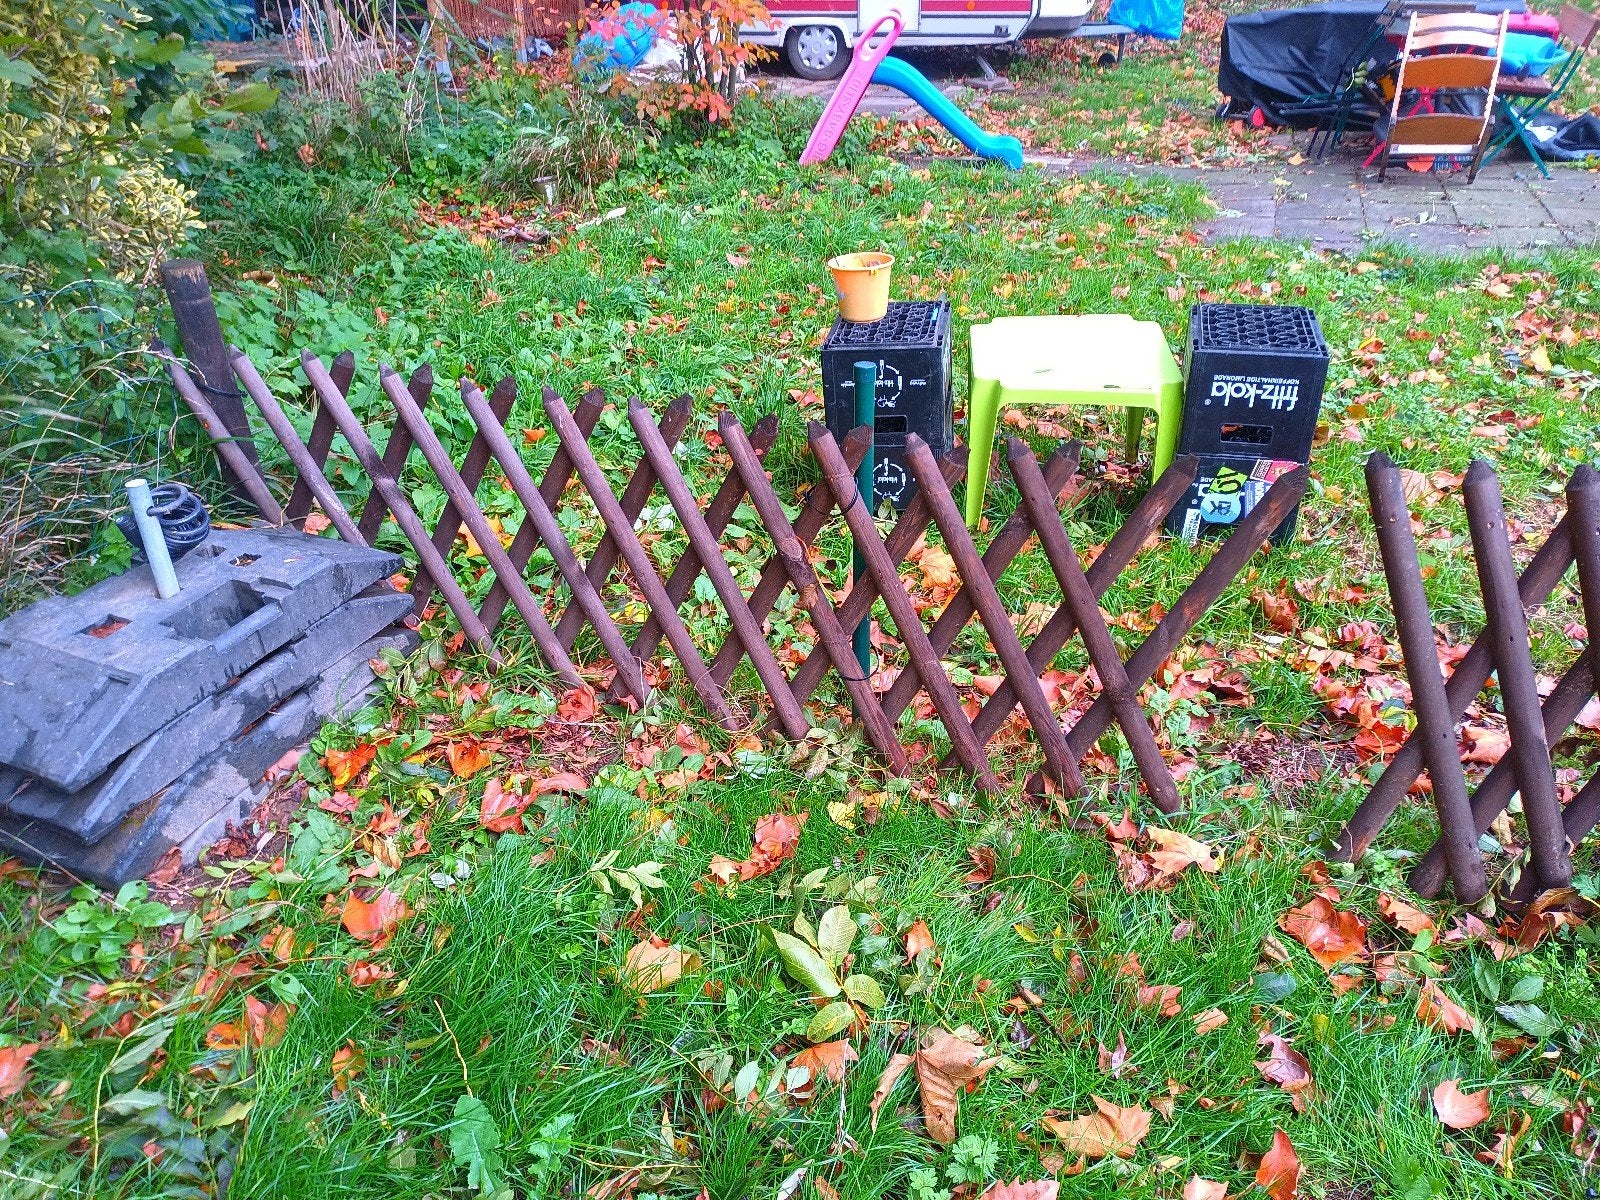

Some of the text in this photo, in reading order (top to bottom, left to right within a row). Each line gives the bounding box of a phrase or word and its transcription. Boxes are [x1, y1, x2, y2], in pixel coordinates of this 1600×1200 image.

[1213, 374, 1300, 385] KOFFEINHALTIGE LIMONADE
[1210, 381, 1299, 411] fritz-kola
